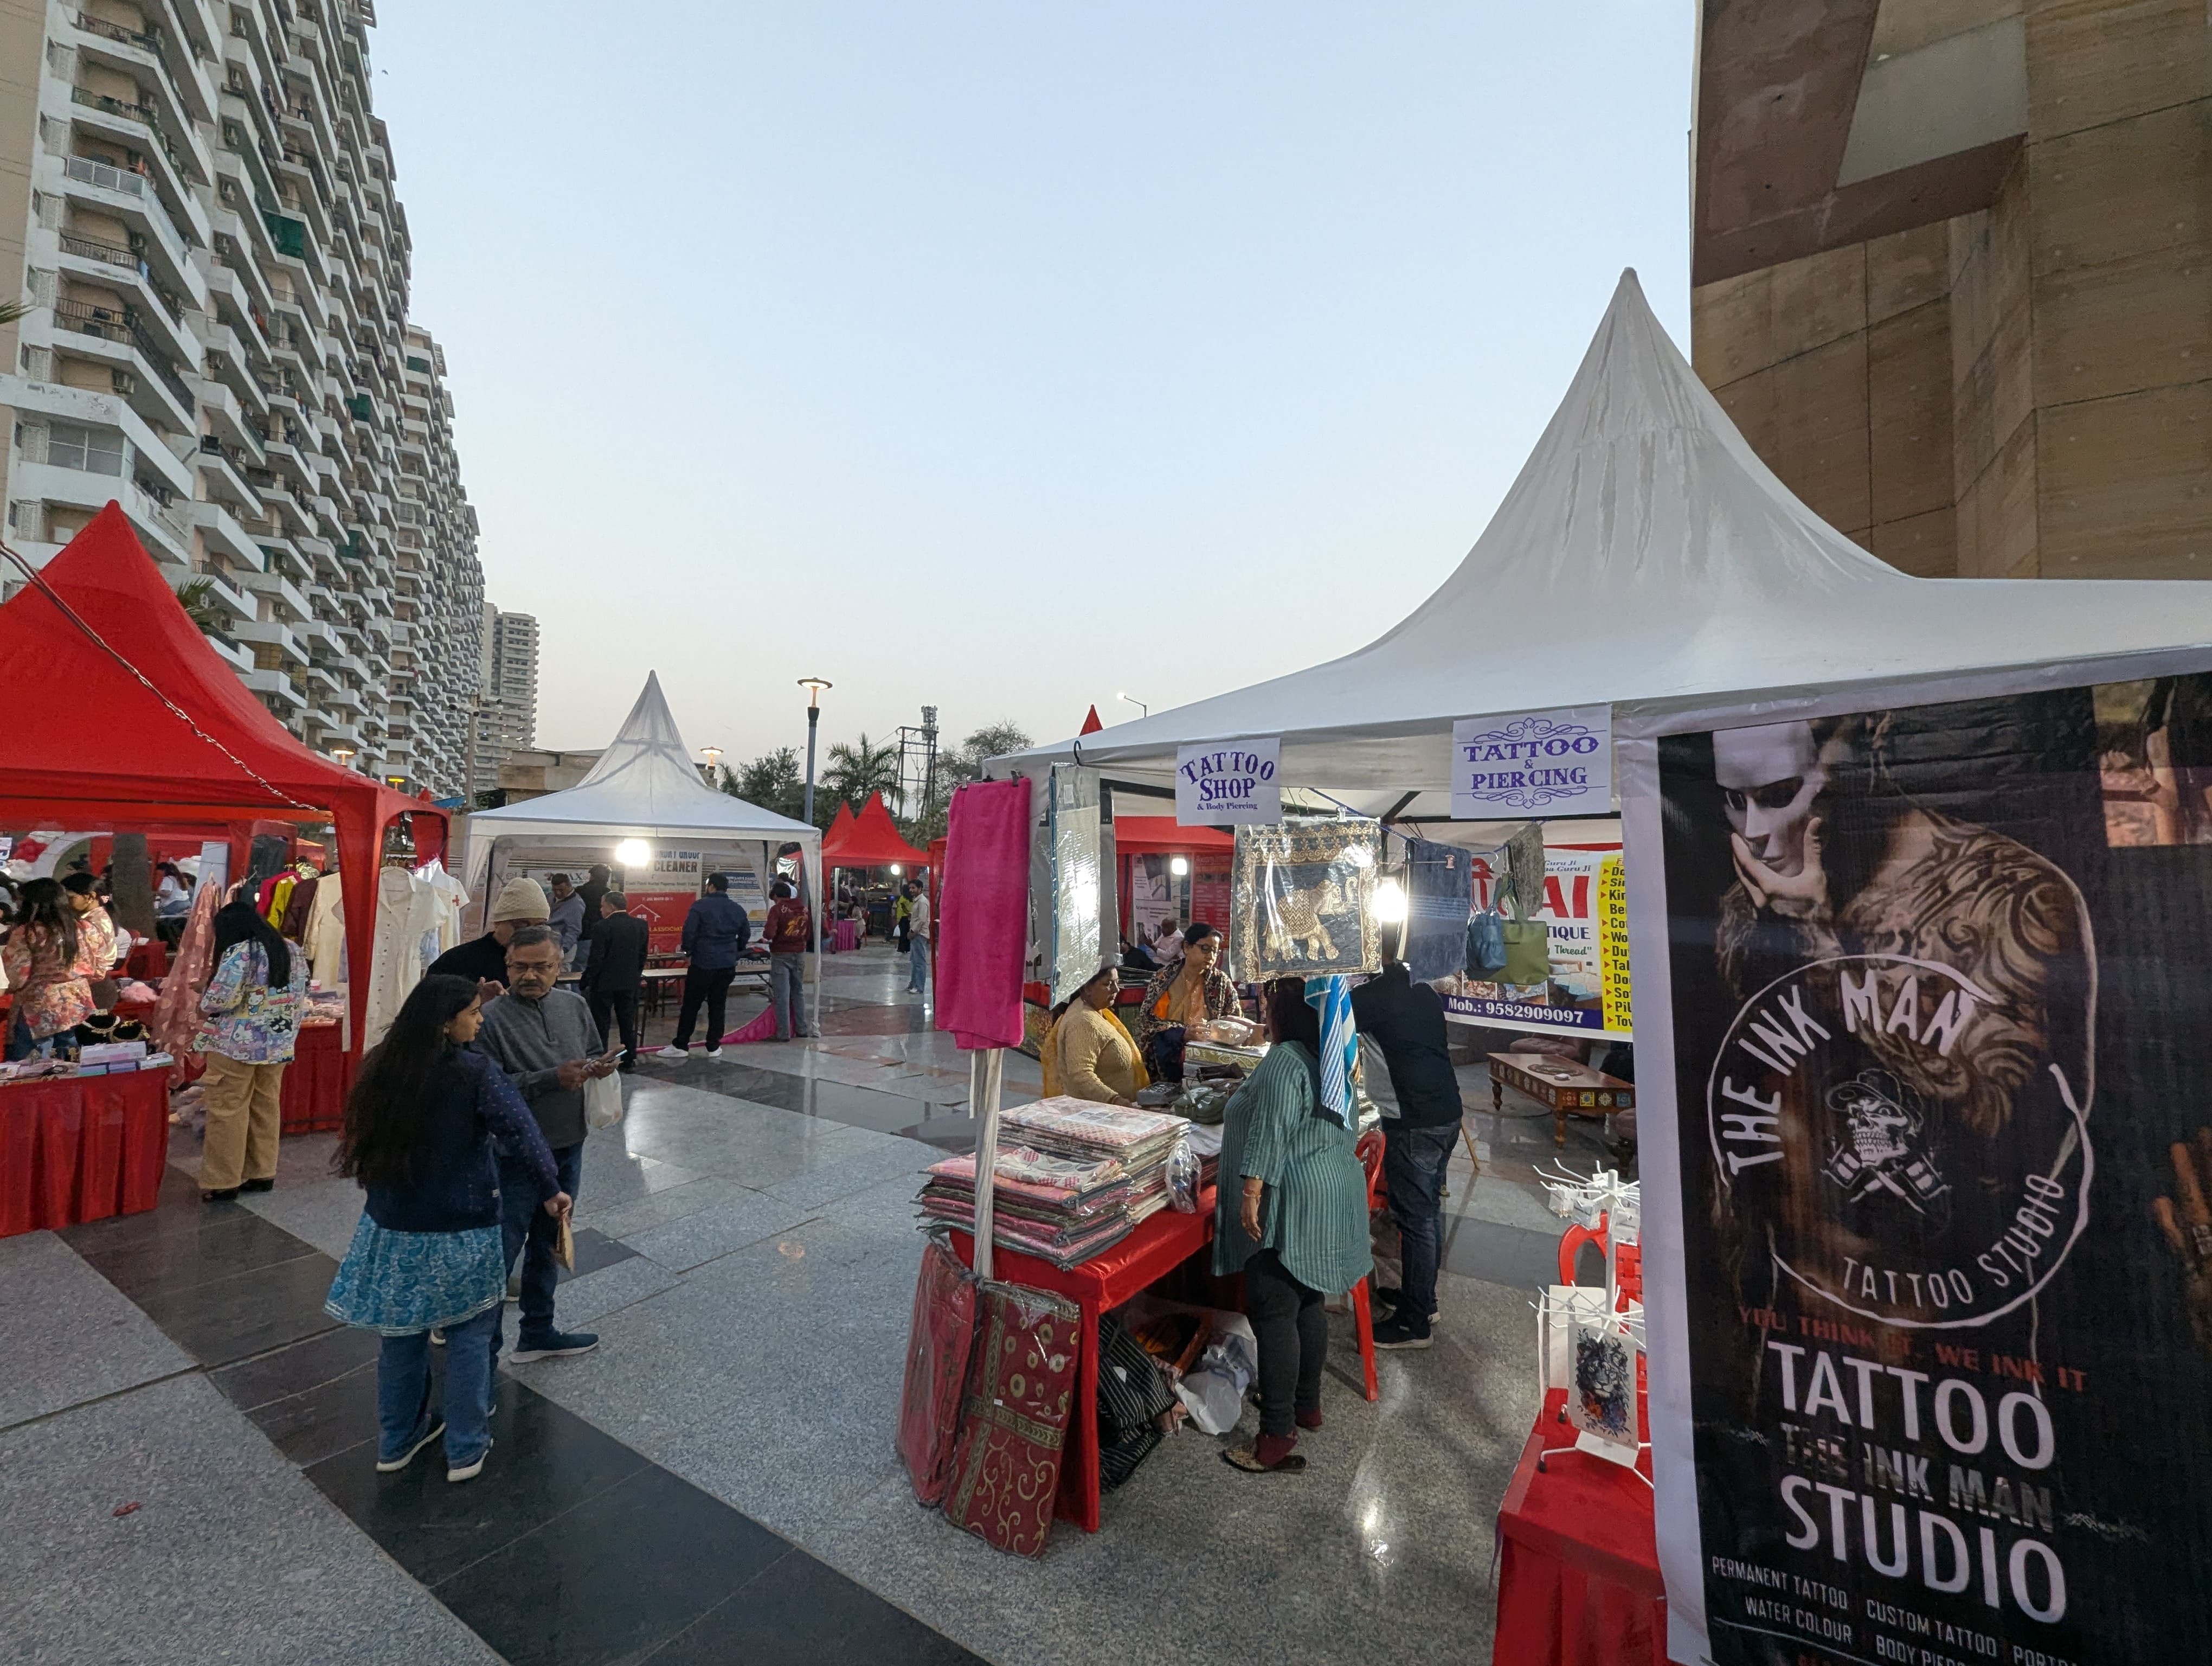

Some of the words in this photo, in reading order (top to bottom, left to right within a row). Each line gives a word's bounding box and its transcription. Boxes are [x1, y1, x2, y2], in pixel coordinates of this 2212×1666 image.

[1179, 751, 1275, 785] TATTOO
[1463, 736, 1599, 762] TATTOO
[1471, 766, 1588, 790] PIERCING
[1524, 759, 1534, 769] &
[1199, 777, 1256, 802] SHOP
[1206, 802, 1224, 811] Body
[1226, 802, 1258, 811] Piercing
[654, 861, 698, 873] CLEANER
[1547, 926, 1591, 941] TIQUE
[1486, 1002, 1584, 1024] 9582909097
[1738, 984, 1831, 1076] INK
[1841, 968, 1977, 1056] MAN
[1721, 1076, 1785, 1175] THE
[1843, 1257, 1974, 1309] TATTOO
[1977, 1173, 2065, 1287] STUDIO
[1797, 1315, 1876, 1348] THINK
[1935, 1342, 1980, 1372] WE
[1992, 1354, 2046, 1385] INK
[2055, 1367, 2088, 1393] IT
[1767, 1340, 2055, 1470] TATTOO
[1863, 1442, 1934, 1502] INK
[1949, 1464, 2054, 1533] MAN
[1780, 1473, 2067, 1624] STUDIO
[1712, 1555, 1788, 1591] PERMANENT
[1792, 1574, 1848, 1610] TATTOO
[1866, 1598, 1931, 1636] CUSTOM
[1935, 1619, 1999, 1658] TATTOO
[1745, 1595, 1791, 1624] WATER
[1795, 1609, 1852, 1644] COLOUR
[1875, 1635, 1917, 1666] BODY
